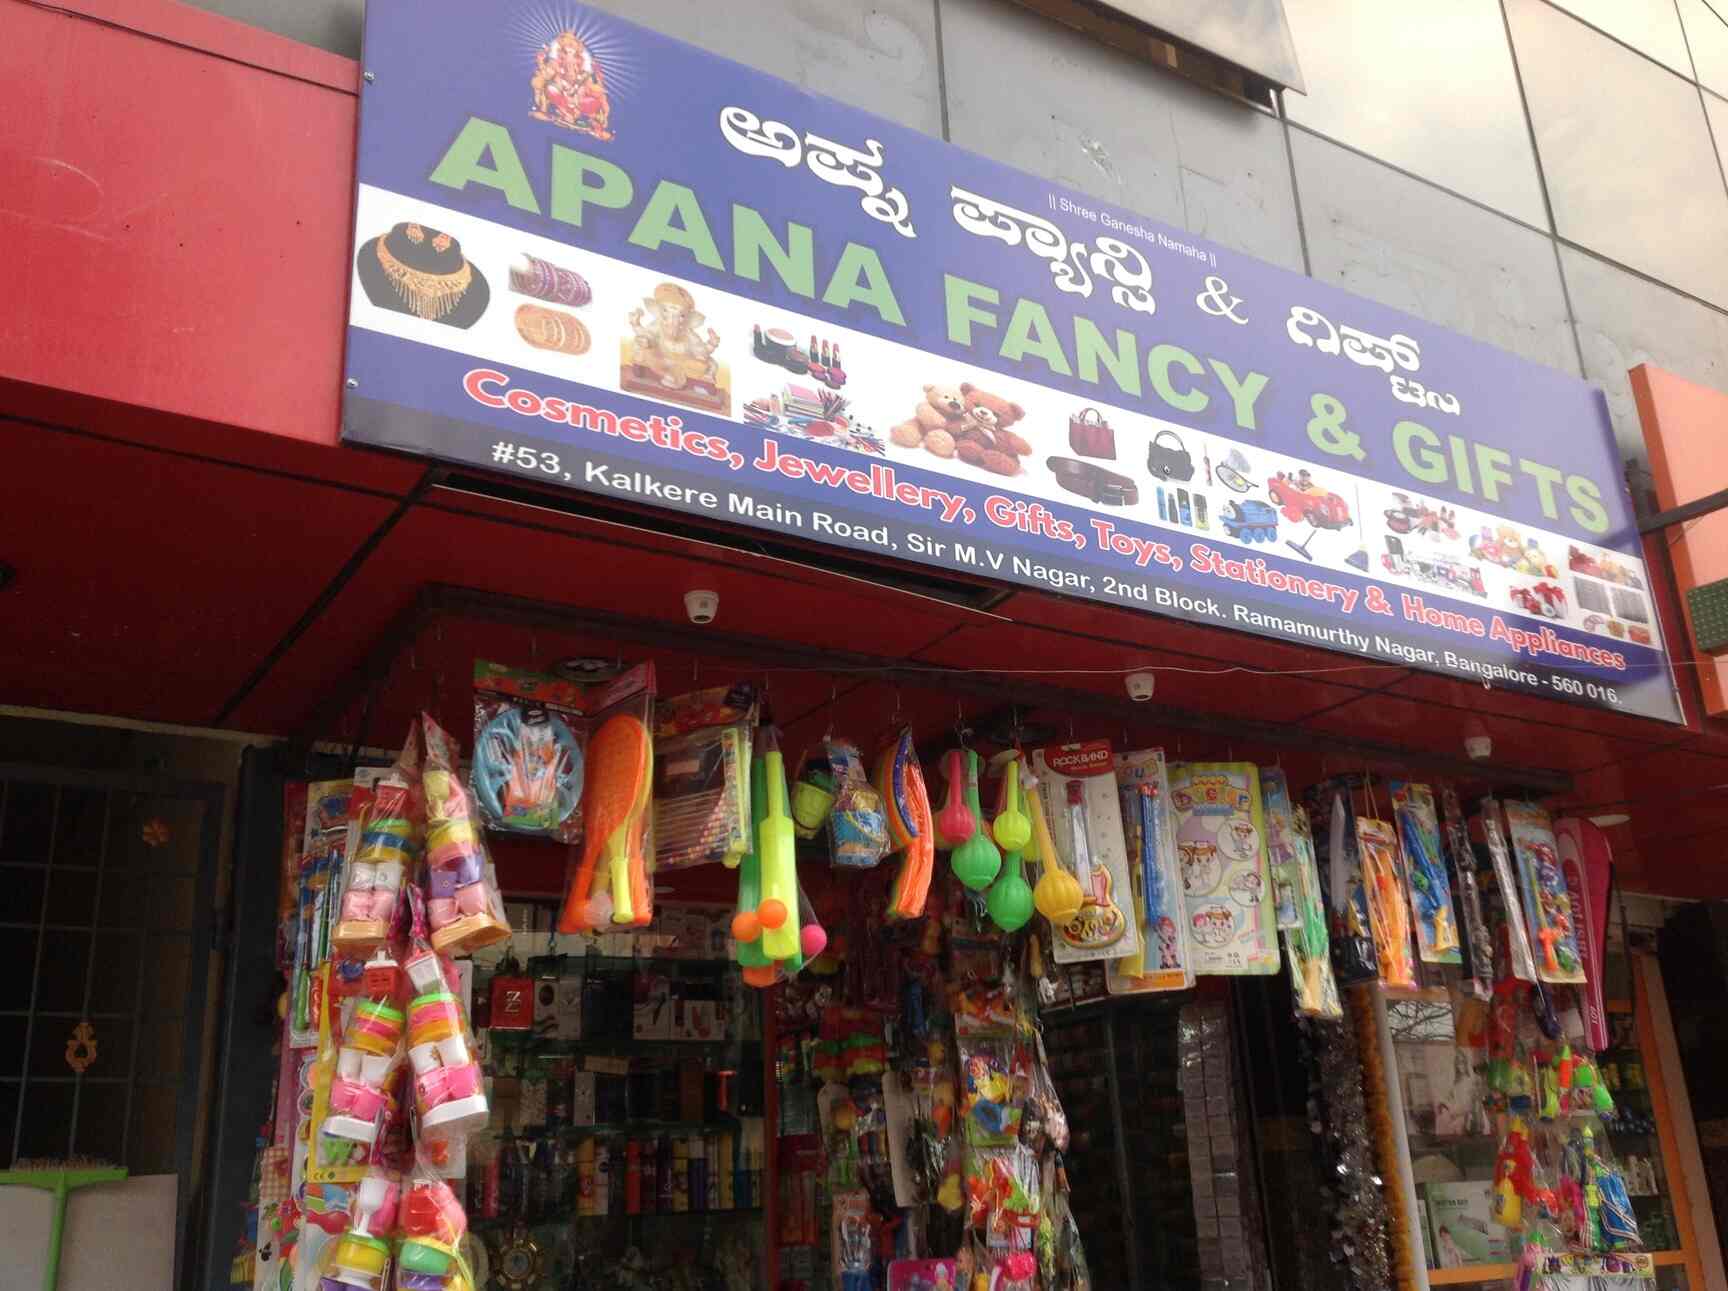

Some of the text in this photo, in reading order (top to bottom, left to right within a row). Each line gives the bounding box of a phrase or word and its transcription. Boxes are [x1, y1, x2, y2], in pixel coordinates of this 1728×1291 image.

[428, 115, 1609, 535] APANA FANCY & GIFTS
[1060, 197, 1097, 222] Shree
[1101, 212, 1155, 243] Ganesha
[1158, 233, 1206, 262] Namaha
[1196, 276, 1248, 325] &
[463, 368, 1627, 671] Cosmetics, Jewellery, Gifts, Toys, Stationery & Home Appliances
[491, 441, 571, 481] #53,
[584, 460, 719, 509] Kalkere
[728, 493, 803, 528] Main
[812, 512, 898, 551] Road,
[907, 533, 947, 558] Sir
[954, 543, 1004, 570] M.V
[1012, 556, 1096, 594] Nagar,
[1103, 576, 1148, 602] 2nd
[1154, 587, 1228, 619] Block.
[1233, 604, 1370, 653] Ramamurthy
[1375, 635, 1440, 666] Nagar,
[1444, 650, 1539, 687] Bangalore
[1552, 675, 1584, 697] 560
[1586, 683, 1624, 706] 016.
